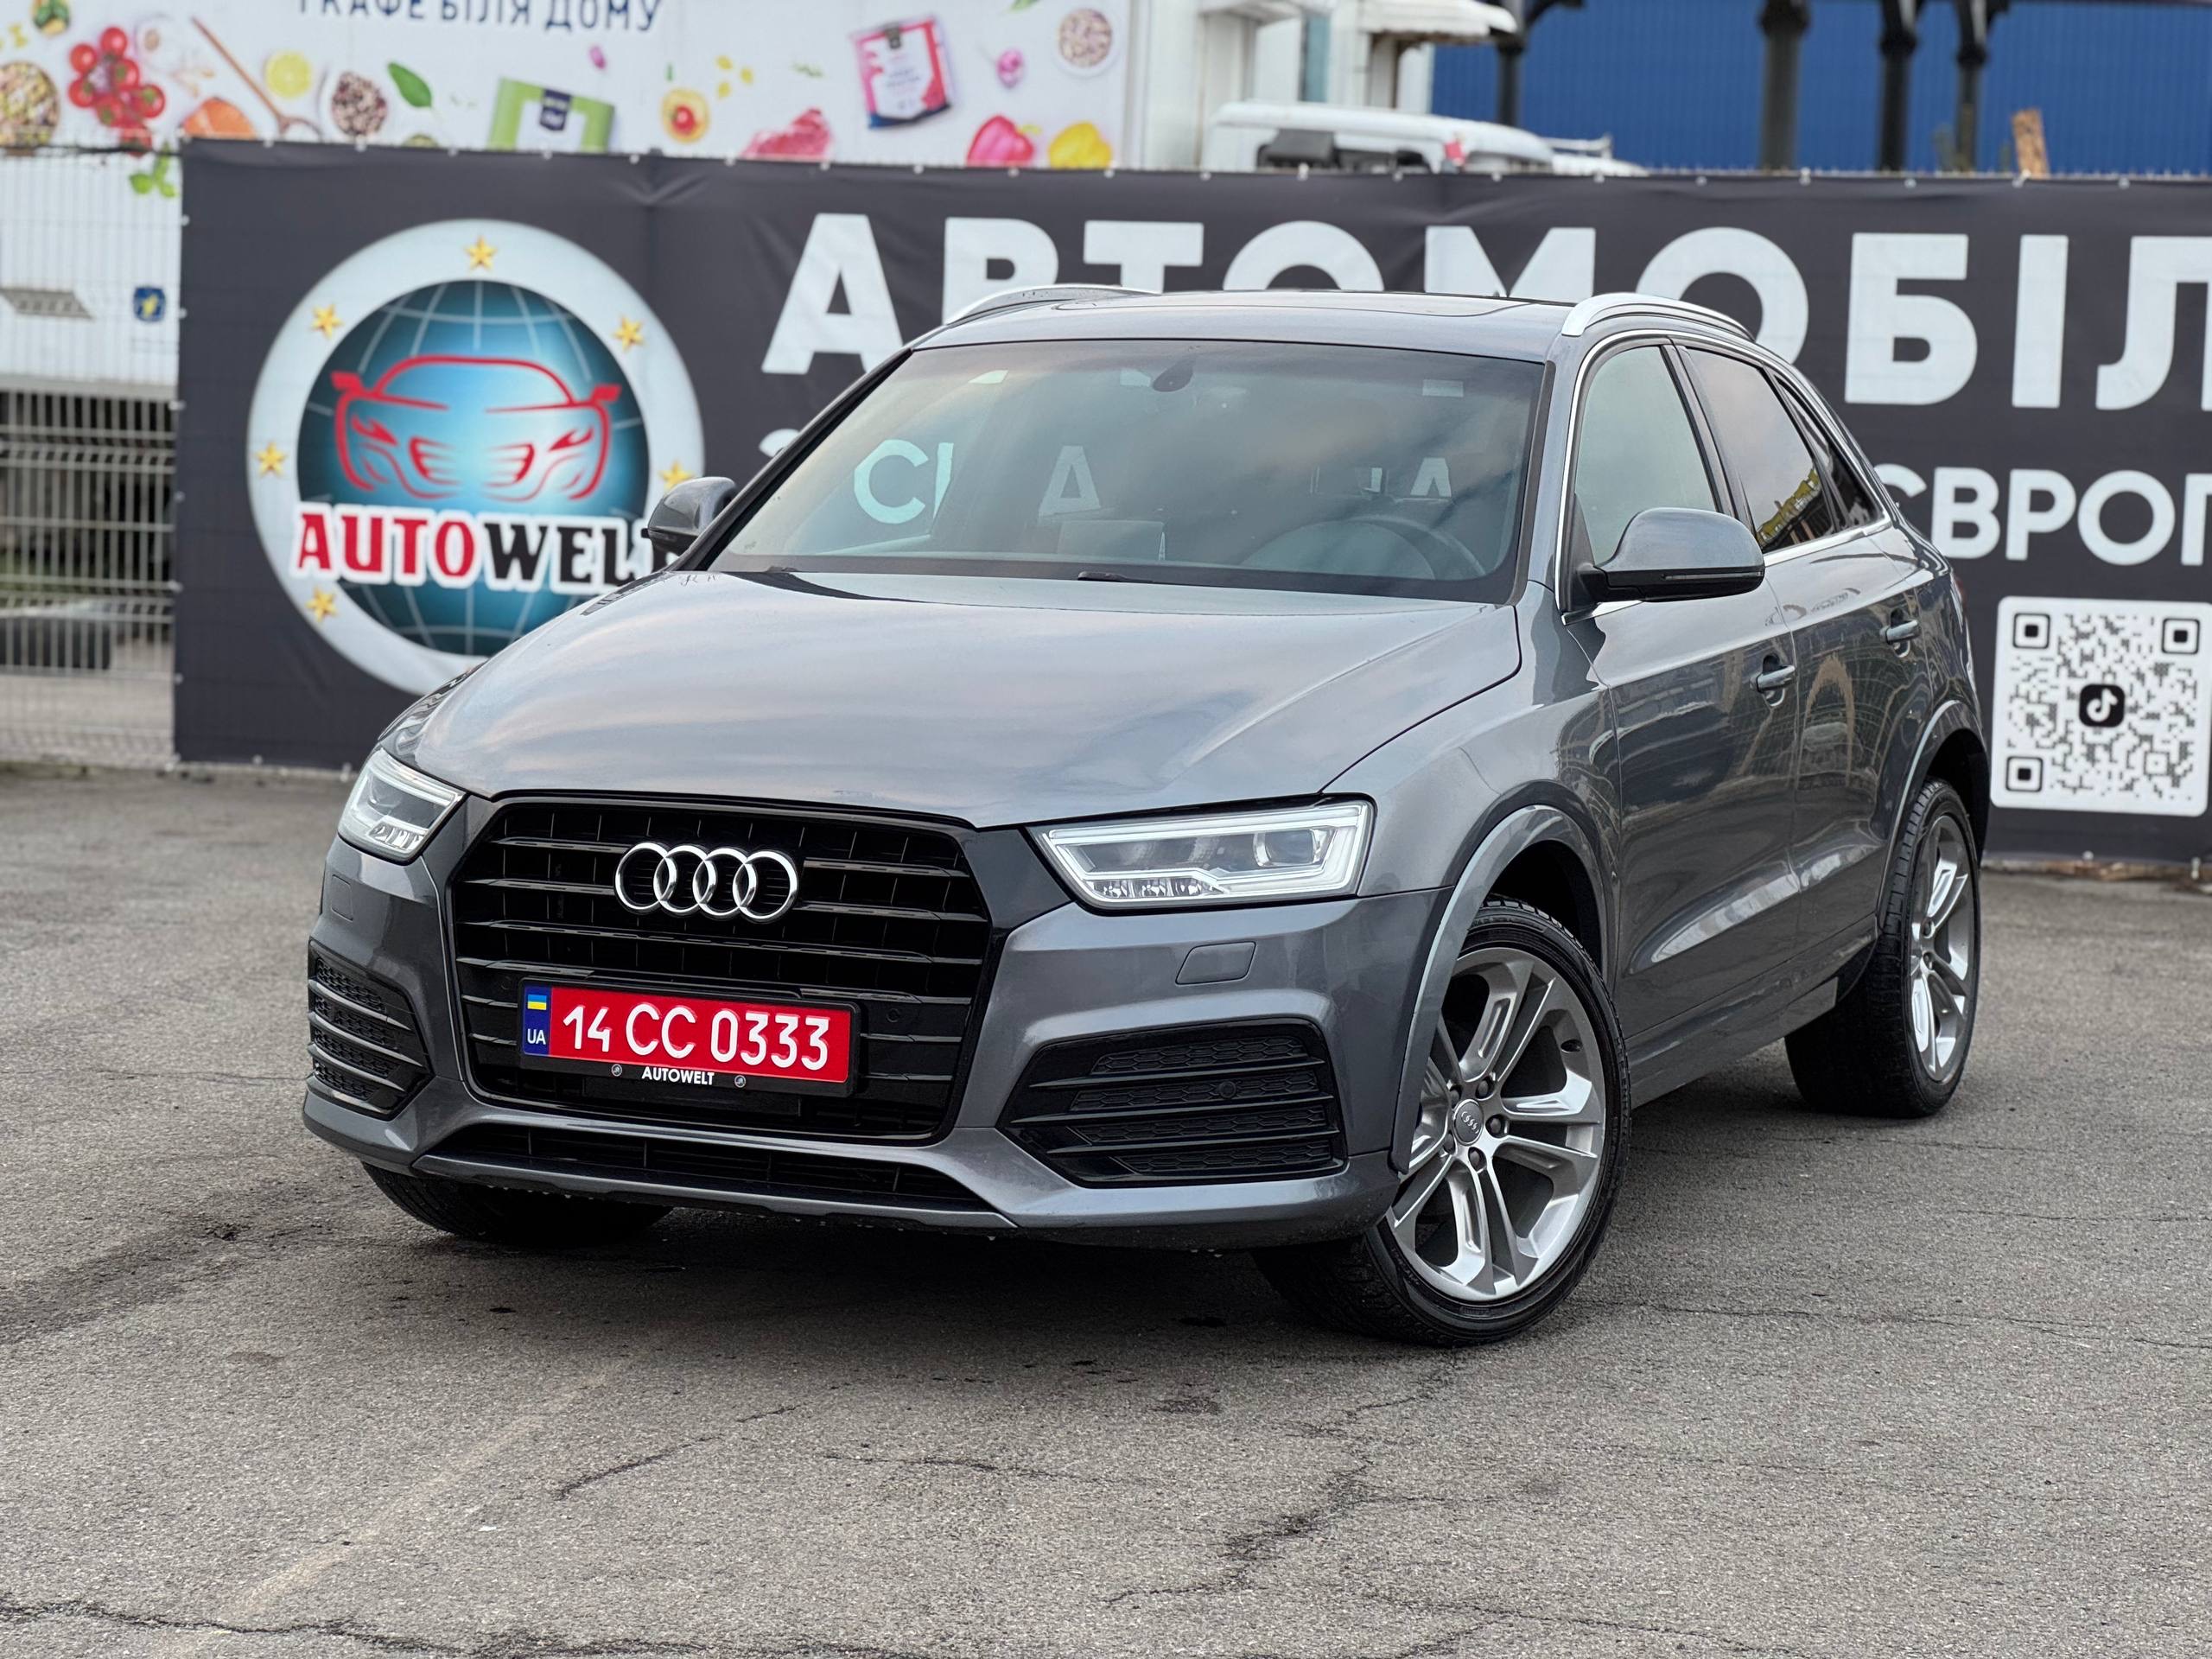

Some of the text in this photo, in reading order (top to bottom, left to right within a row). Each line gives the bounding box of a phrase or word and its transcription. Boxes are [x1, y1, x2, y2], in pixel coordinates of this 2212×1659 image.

[544, 0, 662, 32] ДОМУ
[297, 512, 674, 588] AUTOWEL
[527, 1028, 546, 1046] UA
[563, 1002, 830, 1071] 14 CC 0333
[641, 1066, 715, 1085] AUTOWELT
